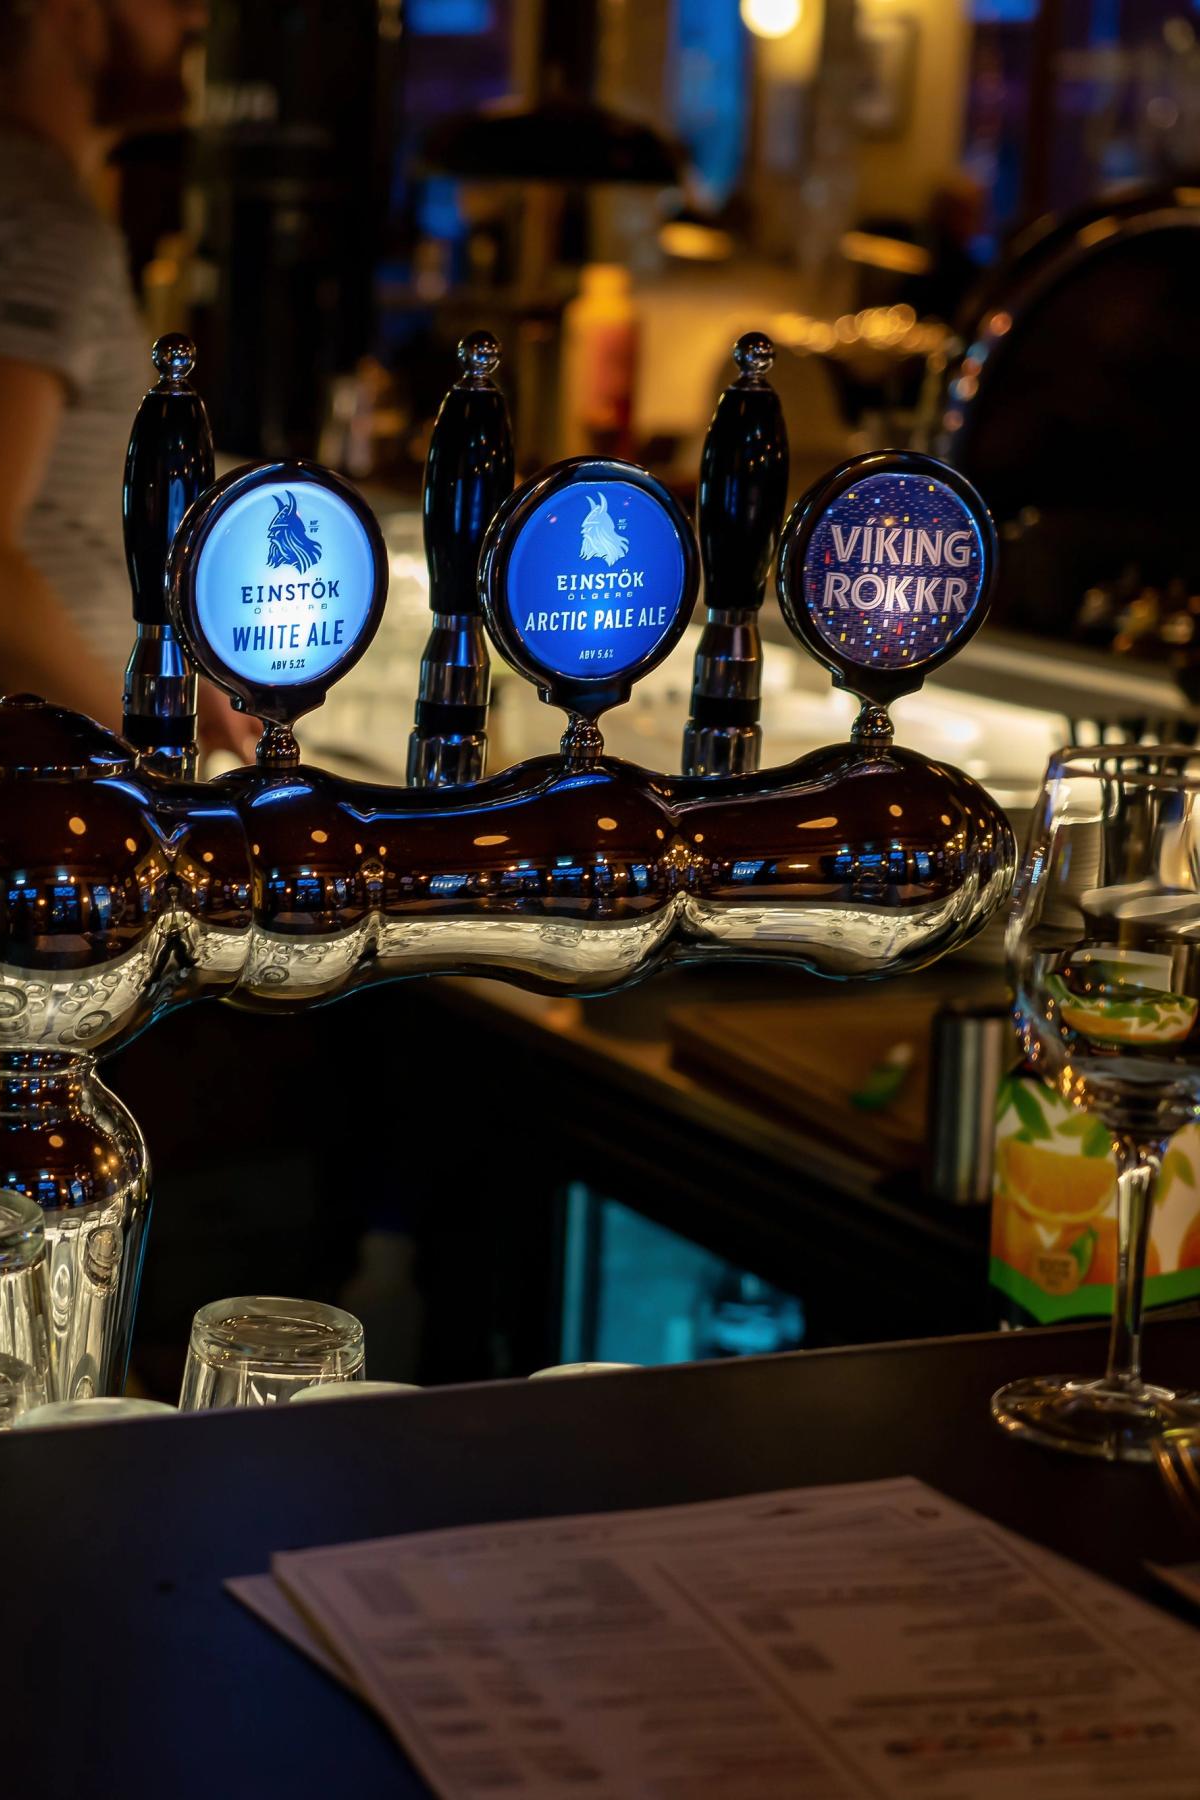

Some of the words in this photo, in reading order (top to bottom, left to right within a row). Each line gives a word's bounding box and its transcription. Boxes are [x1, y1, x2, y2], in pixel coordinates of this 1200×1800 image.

[831, 517, 972, 568] VÍKING
[241, 577, 339, 604] EINSTÖK
[557, 569, 644, 591] EINSTÖK
[823, 566, 968, 614] RÖKKR
[525, 610, 587, 632] ARCTIC
[594, 608, 634, 630] PALE
[638, 606, 667, 627] ALE
[233, 623, 300, 652] WHITE
[306, 620, 344, 647] ALE
[271, 660, 287, 670] ABV
[289, 659, 305, 669] 5.2%
[579, 650, 596, 660] ABV
